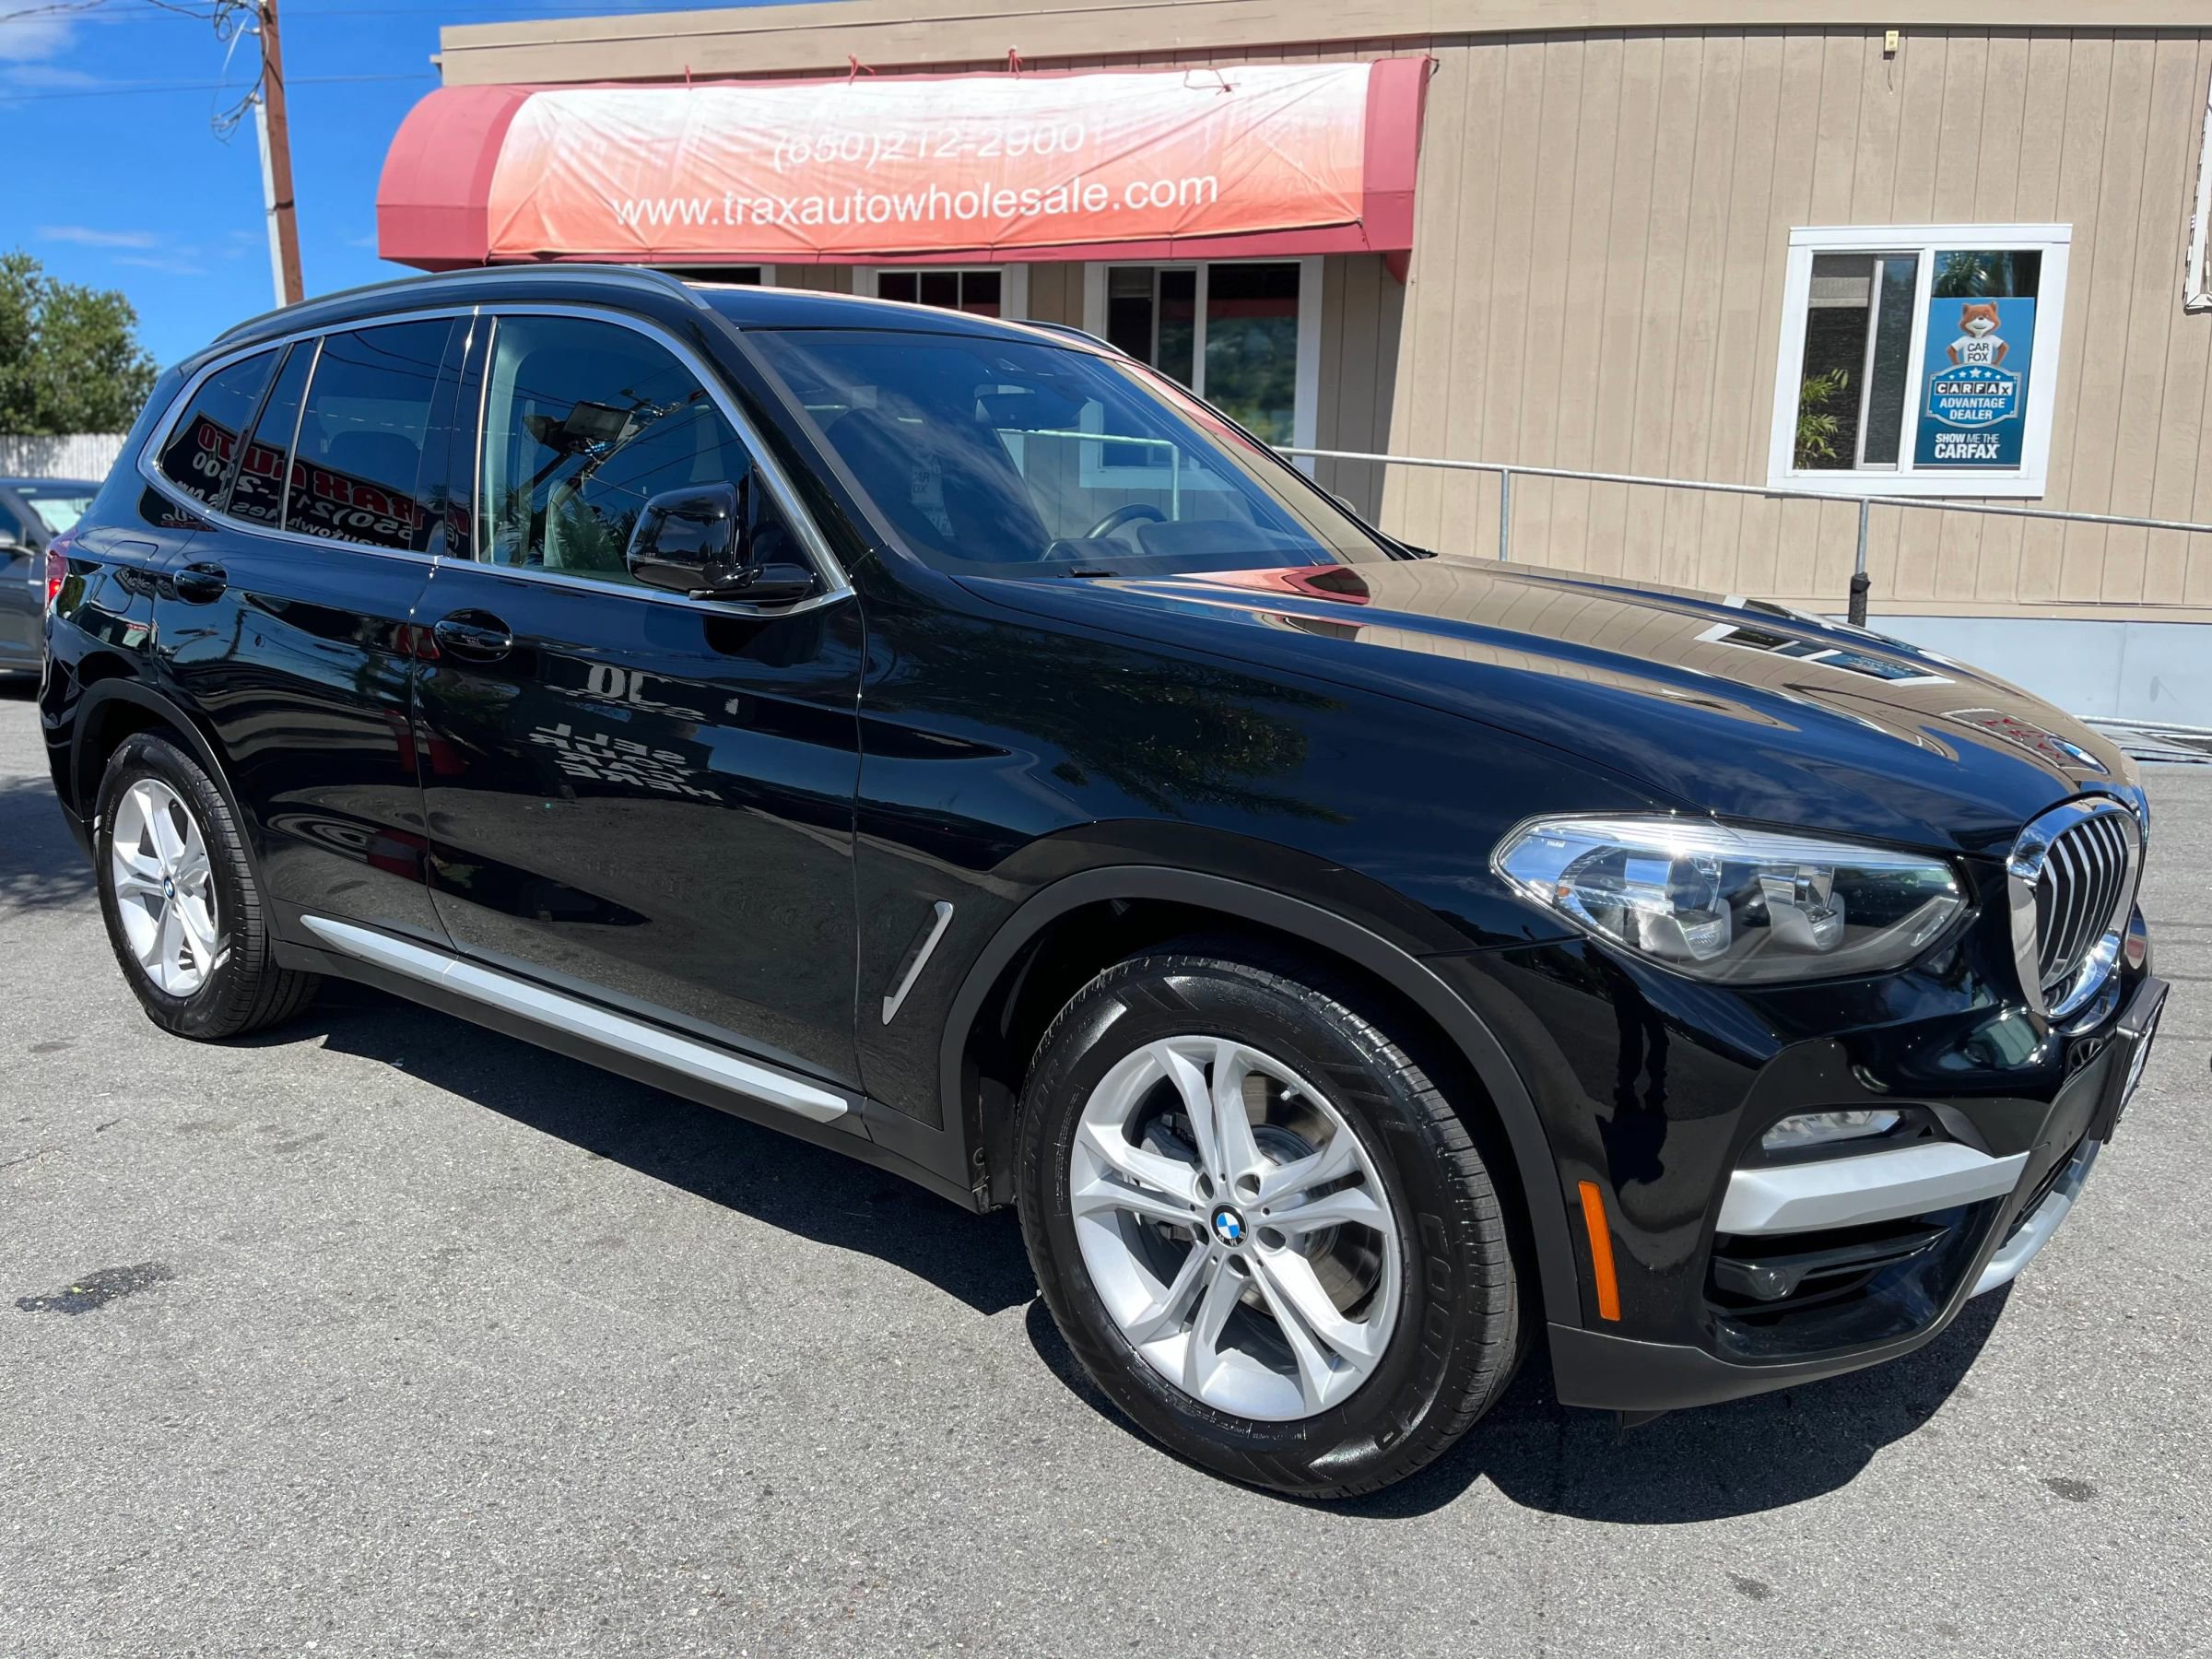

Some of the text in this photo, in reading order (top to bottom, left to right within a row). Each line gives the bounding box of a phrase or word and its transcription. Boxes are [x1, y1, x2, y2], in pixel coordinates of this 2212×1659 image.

[772, 122, 1086, 173] (650)212-2900
[613, 174, 1218, 226] www.traxautowholesale.com
[1967, 343, 1989, 352] CAR
[1967, 352, 1989, 362] FOX
[1936, 382, 2010, 394] CARFAX
[1939, 397, 2006, 408] ADVANTAGE
[1949, 409, 1993, 420] DEALER
[1936, 433, 2000, 443] SHOW ME THE
[1935, 443, 1998, 459] CARFAX
